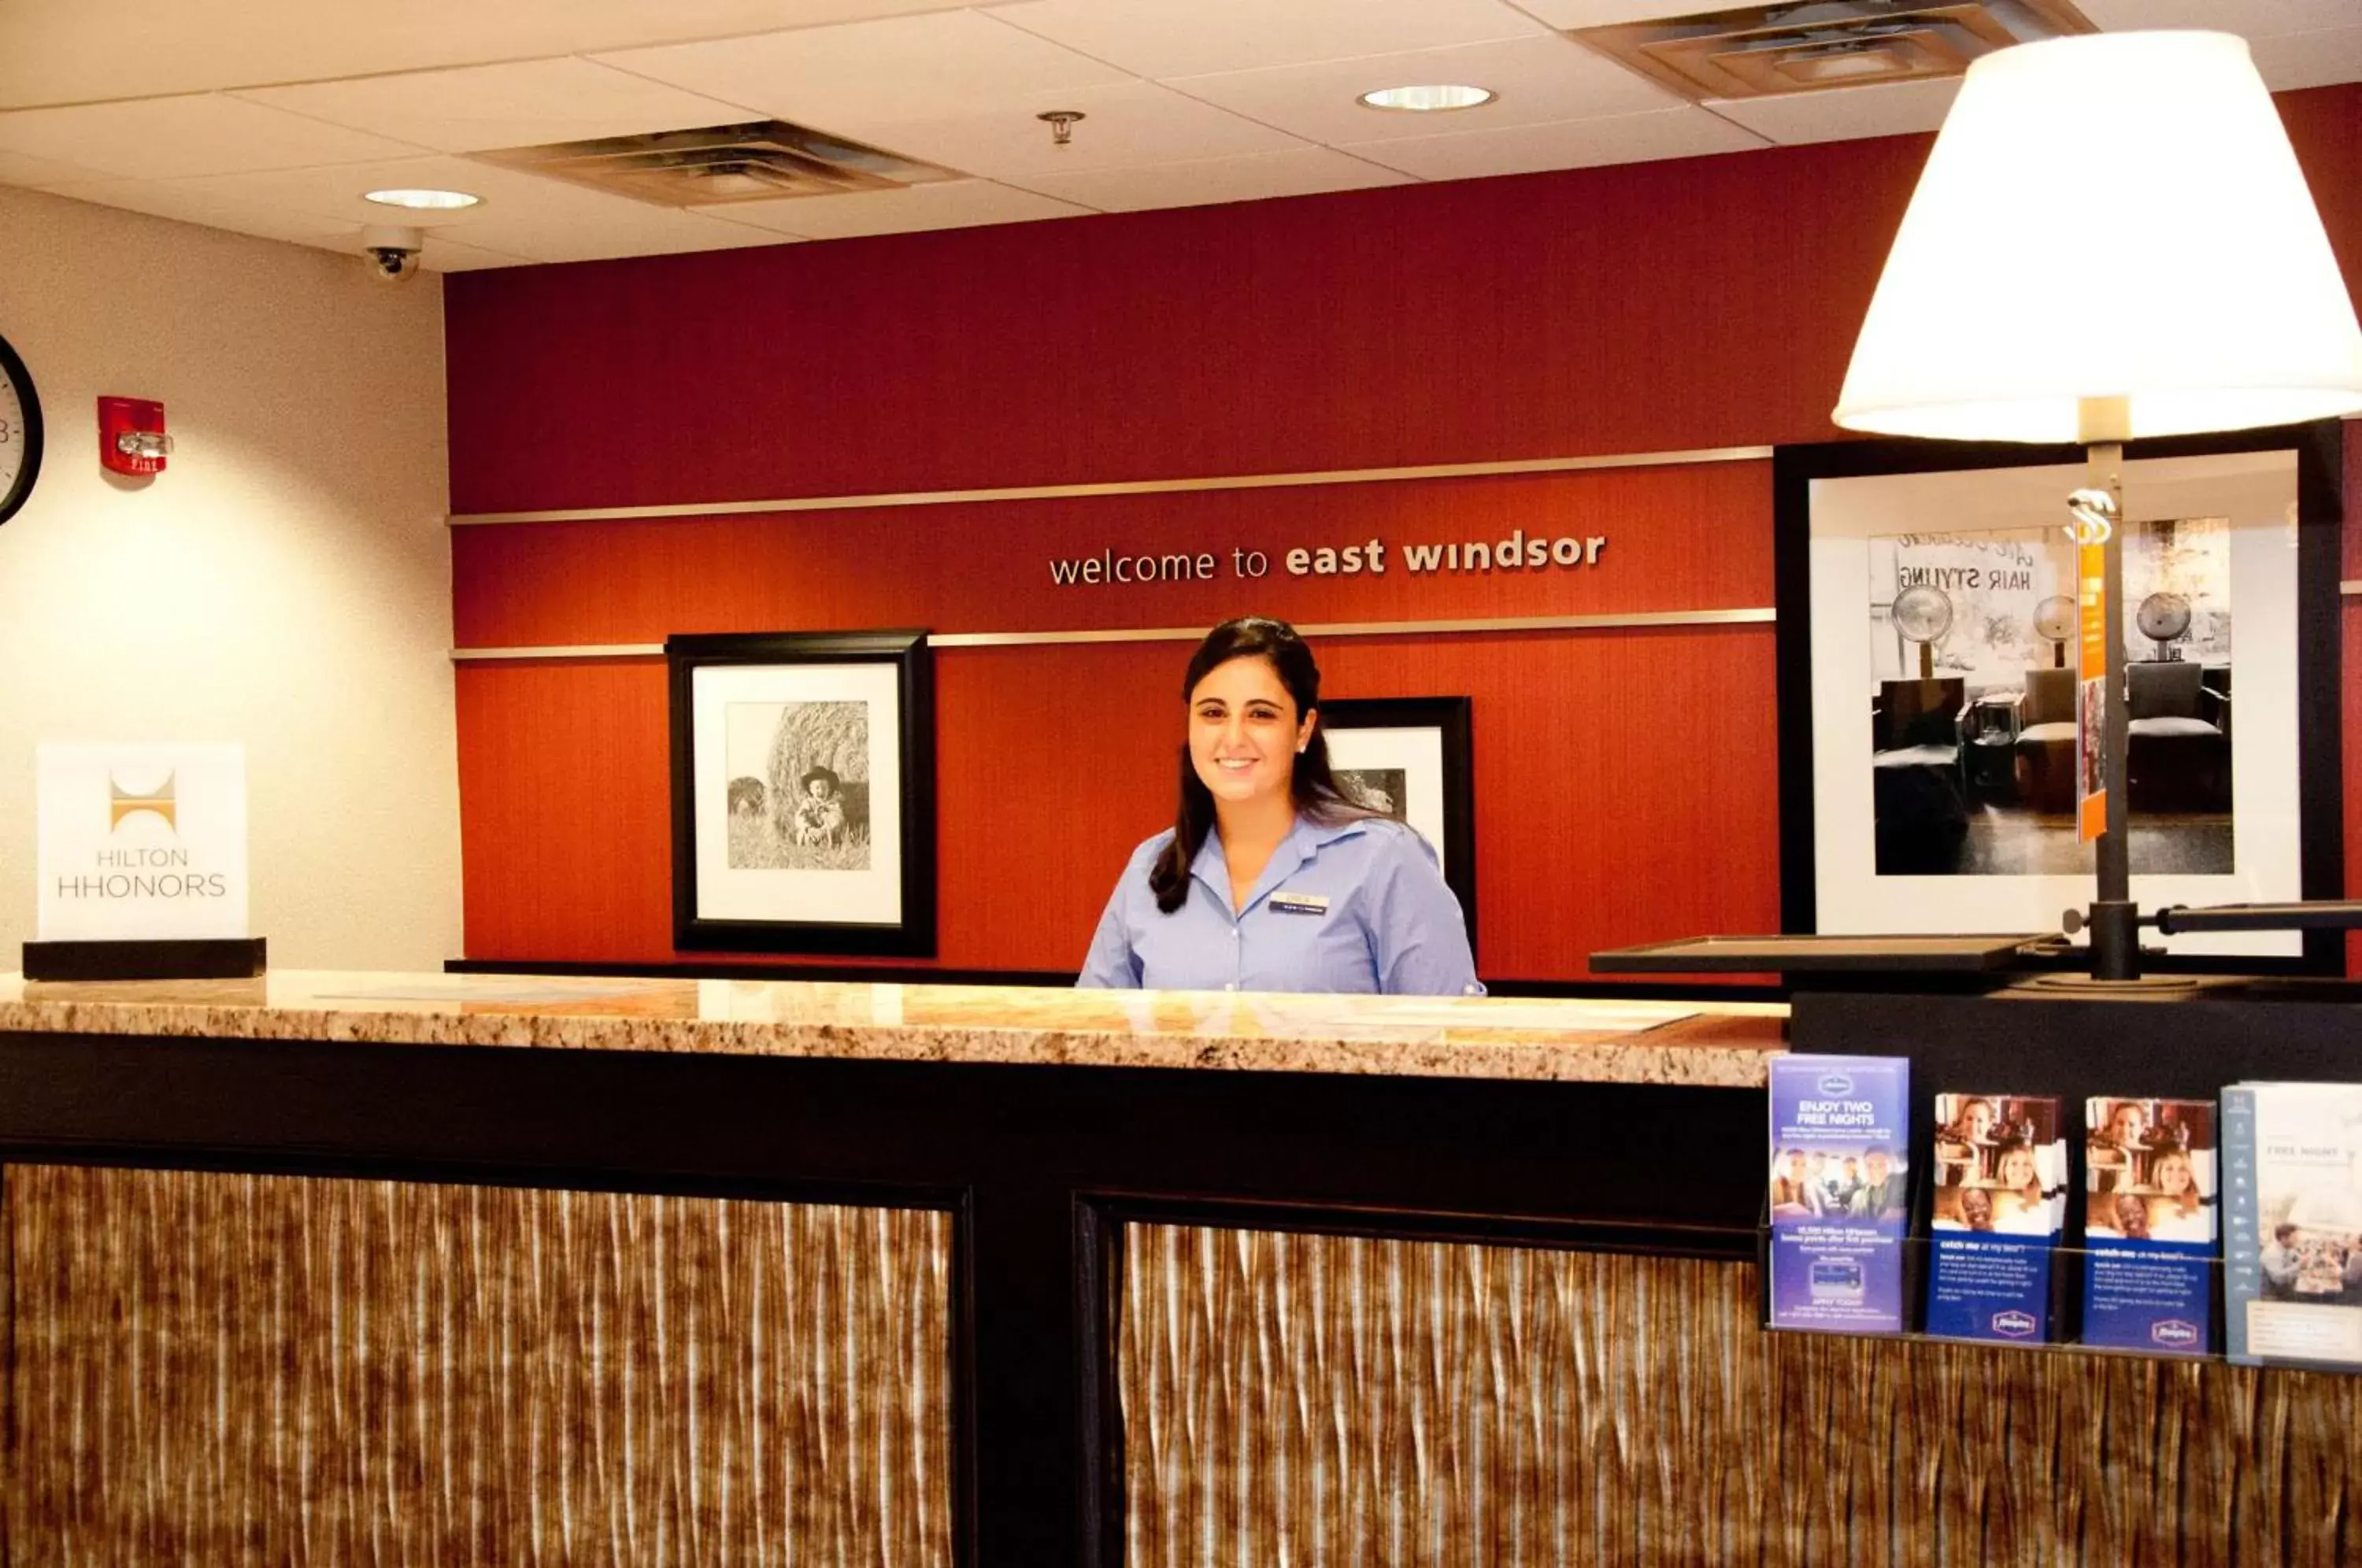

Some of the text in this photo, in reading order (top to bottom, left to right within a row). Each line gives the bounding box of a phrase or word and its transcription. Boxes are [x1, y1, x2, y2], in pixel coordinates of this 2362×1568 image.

[1050, 529, 1607, 586] welcome to east windsor
[97, 847, 189, 867] HILTON
[57, 872, 227, 899] HHONORS
[1799, 1100, 1873, 1113] ENJOY TWO
[1797, 1112, 1875, 1126] FREE NIGHTS
